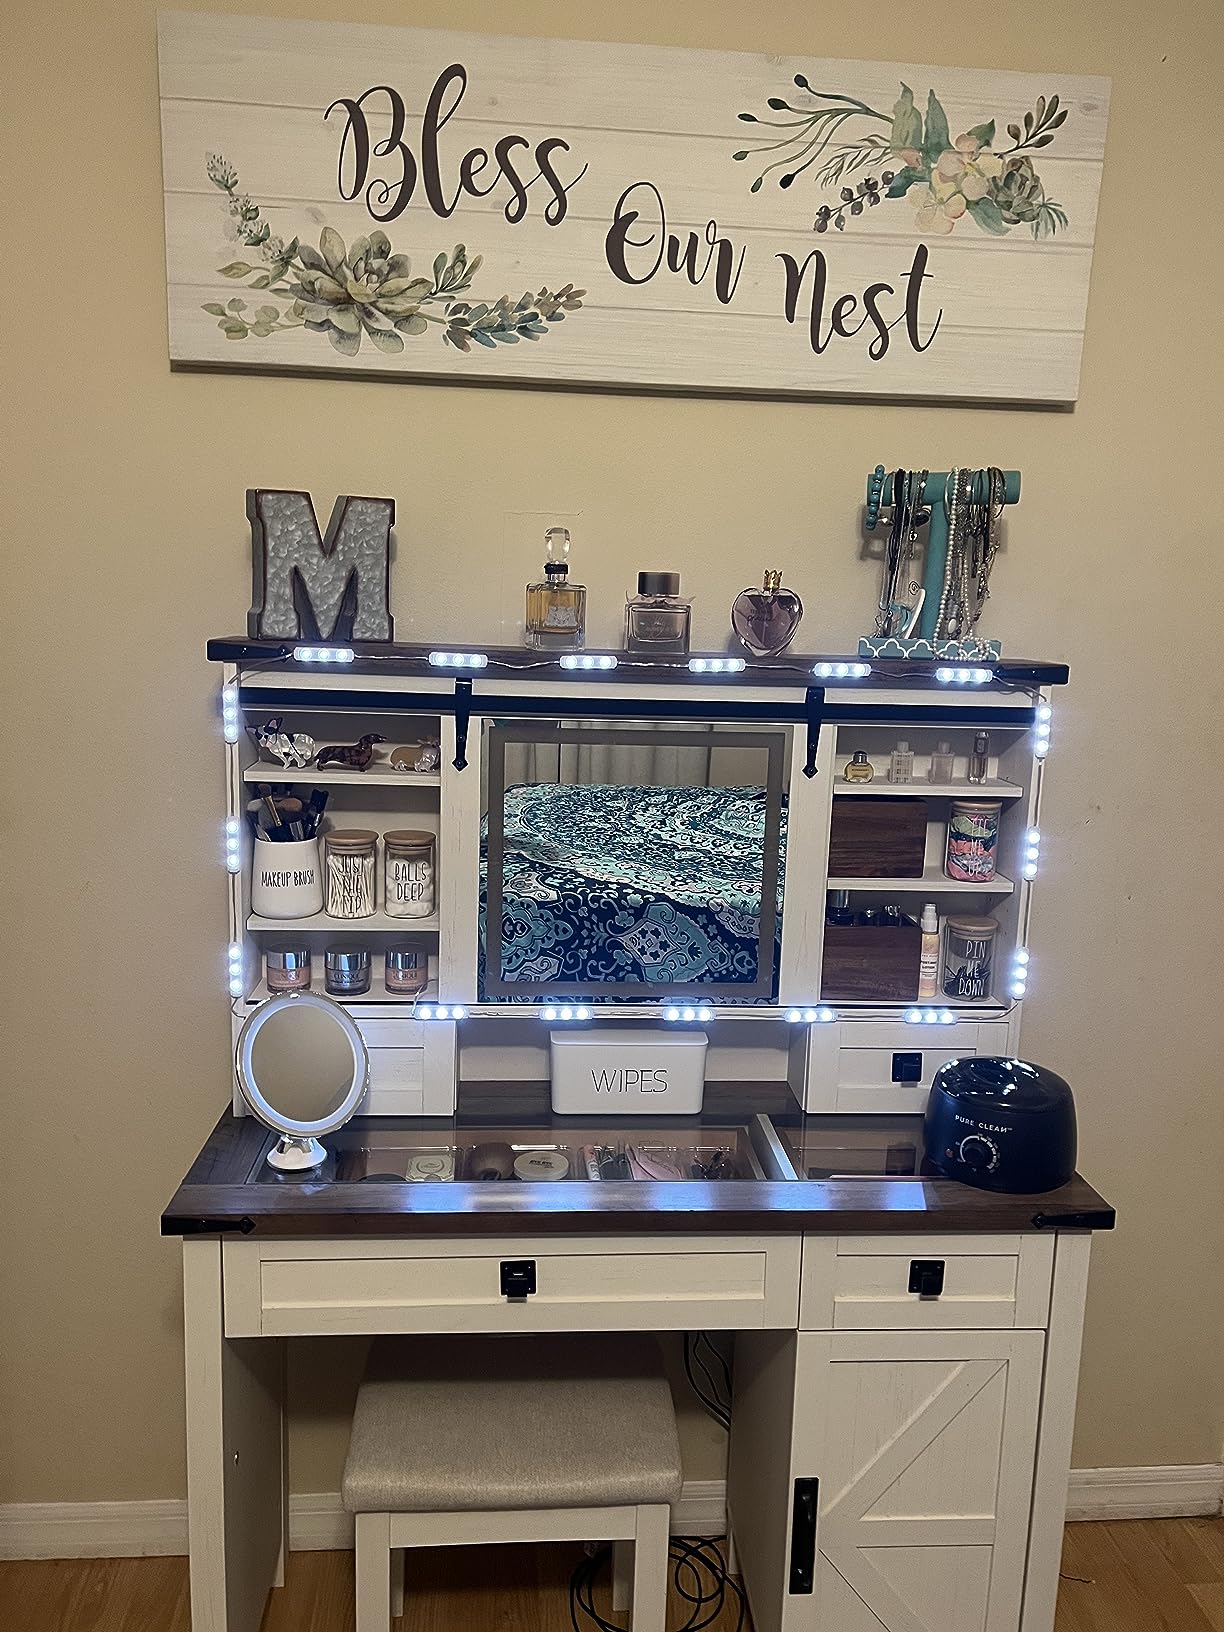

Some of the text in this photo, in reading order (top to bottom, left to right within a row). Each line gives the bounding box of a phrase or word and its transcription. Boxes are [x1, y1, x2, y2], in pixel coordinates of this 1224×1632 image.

[323, 63, 590, 227] Bless
[605, 181, 747, 305] Our
[245, 488, 396, 643] M
[260, 869, 315, 888] MAKEUP BRUSH
[394, 862, 427, 882] BALLS
[396, 882, 424, 902] DEEP
[966, 940, 986, 959] PIN
[966, 959, 981, 979] ME
[958, 977, 985, 996] DOWN
[591, 1069, 668, 1094] WIPES
[955, 1114, 975, 1127] PURE
